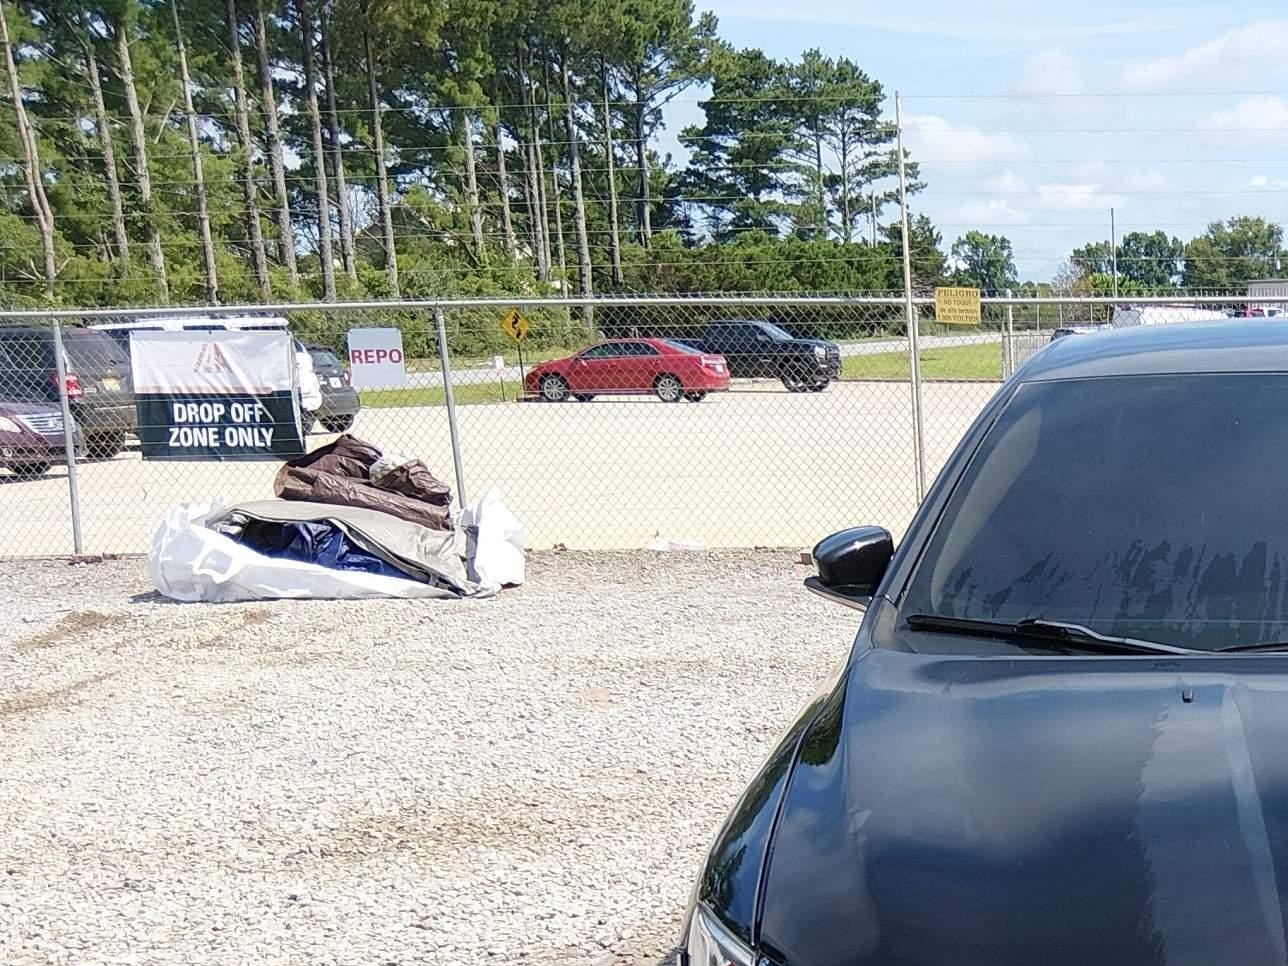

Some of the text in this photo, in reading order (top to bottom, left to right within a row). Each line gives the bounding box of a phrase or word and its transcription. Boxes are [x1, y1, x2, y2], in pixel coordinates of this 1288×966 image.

[937, 289, 978, 298] PELIGRO
[351, 348, 402, 364] REPO
[173, 403, 263, 423] DROP OFF
[168, 427, 274, 447] ZONE ONLY
